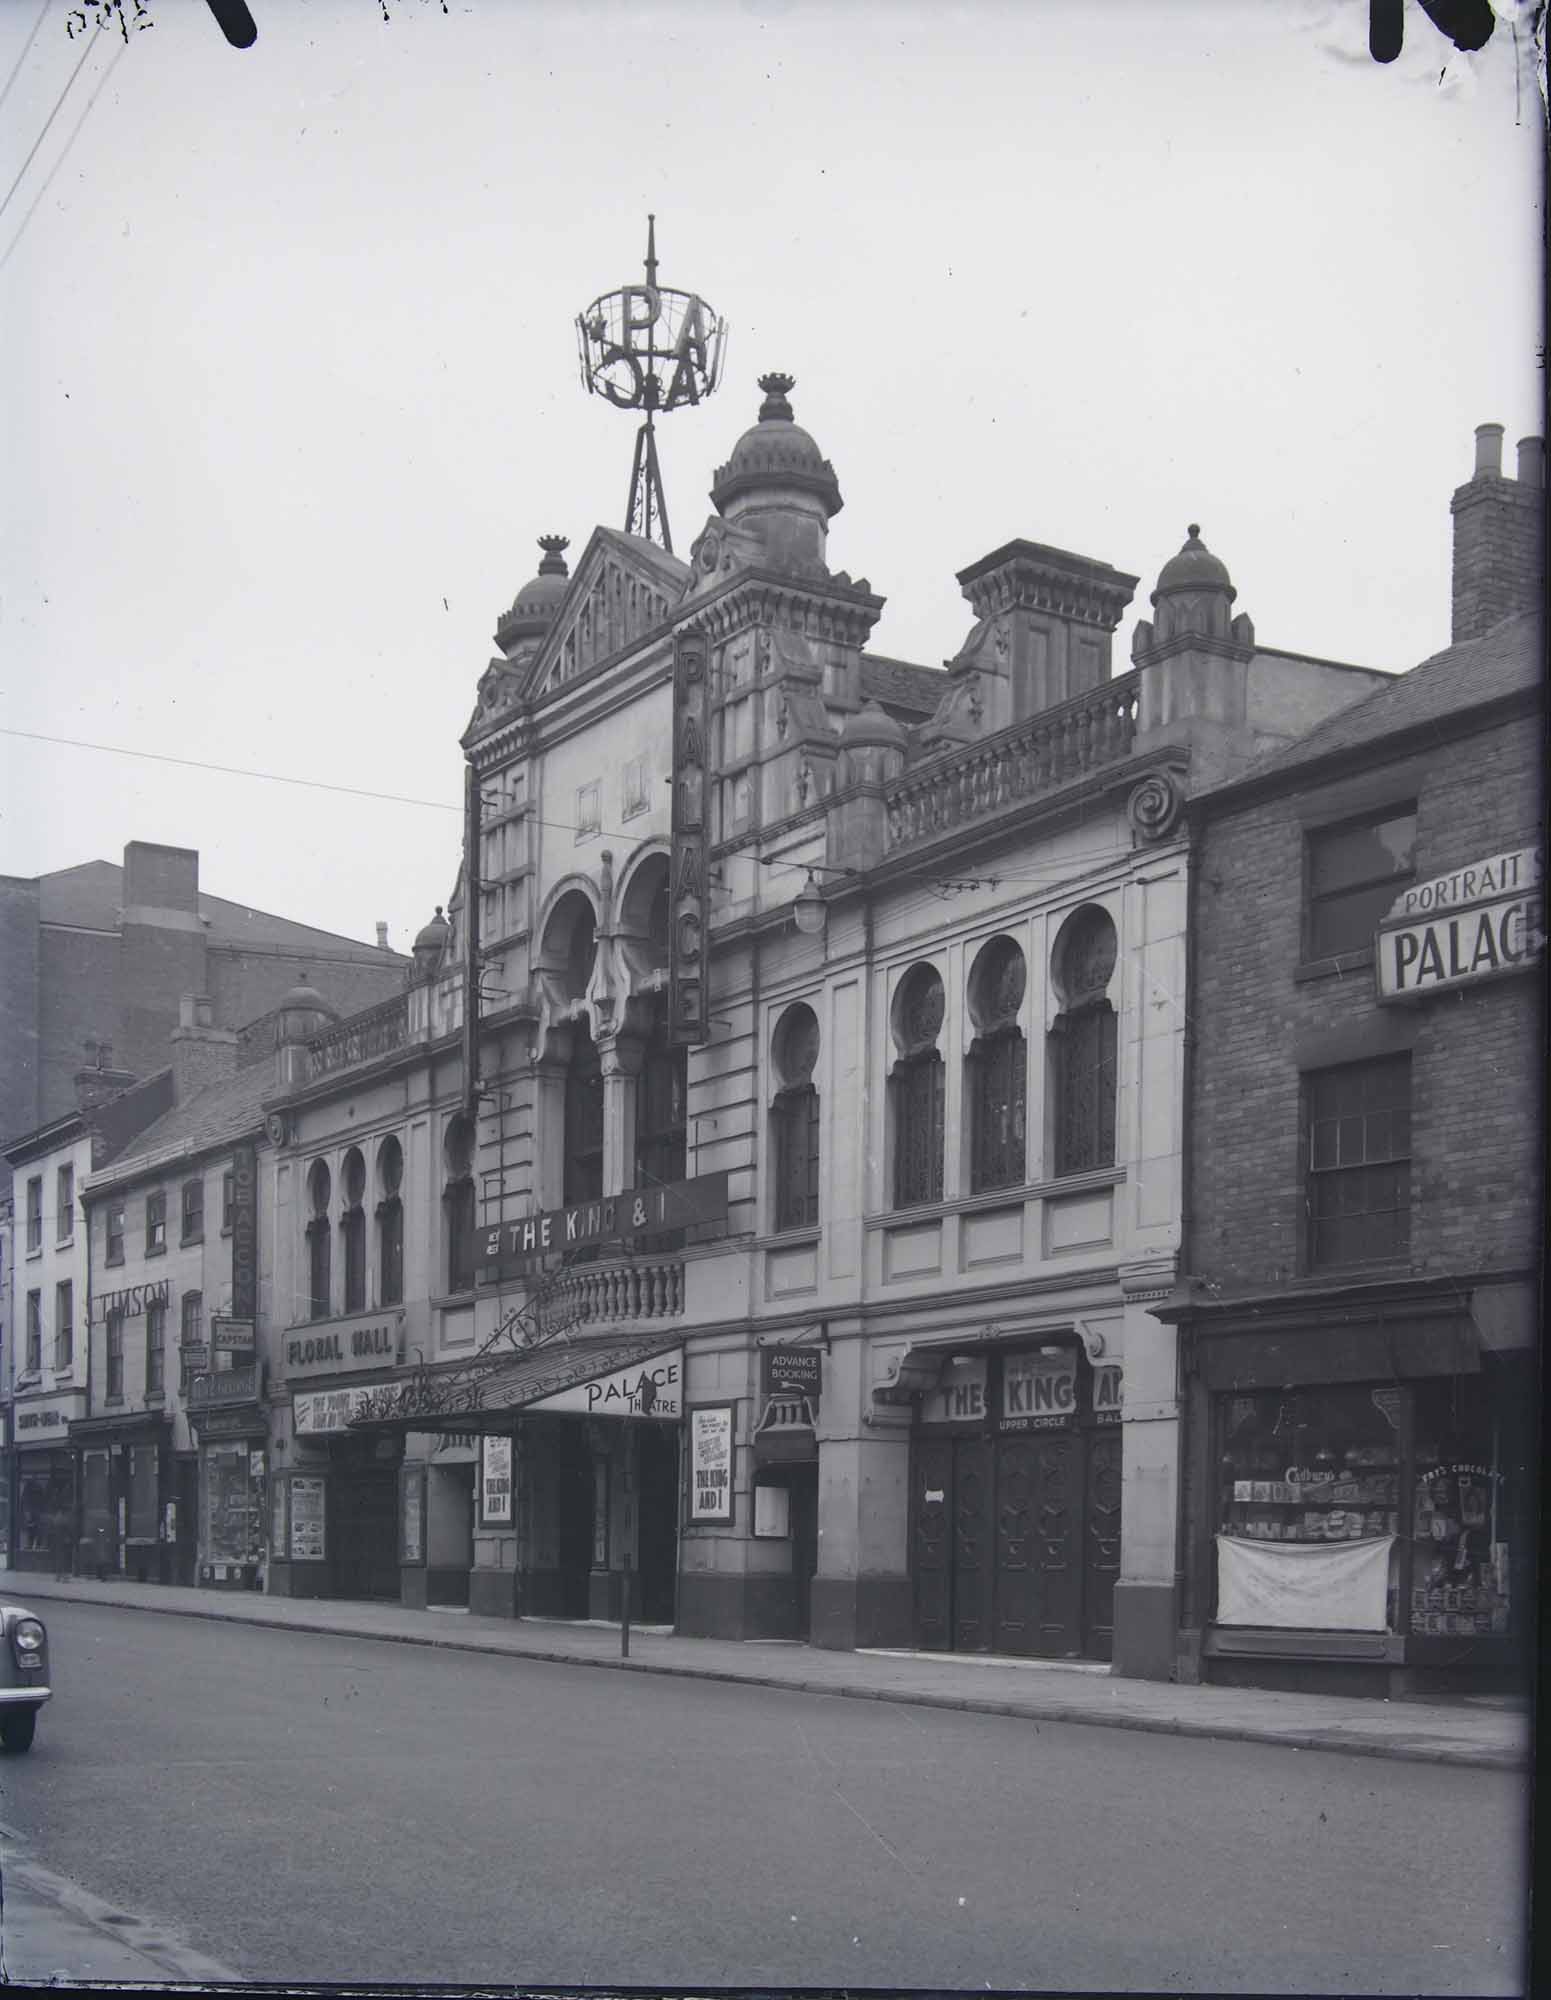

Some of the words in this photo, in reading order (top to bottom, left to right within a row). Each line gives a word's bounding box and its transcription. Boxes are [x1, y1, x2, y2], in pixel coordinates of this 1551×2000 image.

[676, 651, 705, 1030] PALACE
[1405, 854, 1522, 913] PORTRAIT
[509, 1218, 552, 1253] THE
[566, 1203, 616, 1241] KING
[632, 1196, 649, 1227] &
[98, 1278, 169, 1322] TIMSON
[287, 1333, 344, 1366] FLORAL
[351, 1327, 393, 1357] HALL
[772, 1355, 817, 1368] ADVANCE
[584, 1364, 679, 1412] PALACE
[771, 1368, 817, 1380] BOOKING
[627, 1395, 678, 1414] THATRE
[944, 1382, 985, 1417] THE
[1008, 1375, 1072, 1412] KING
[1000, 1417, 1028, 1431] UPPER
[1032, 1416, 1065, 1429] CIRCLE
[697, 1469, 709, 1488] THE
